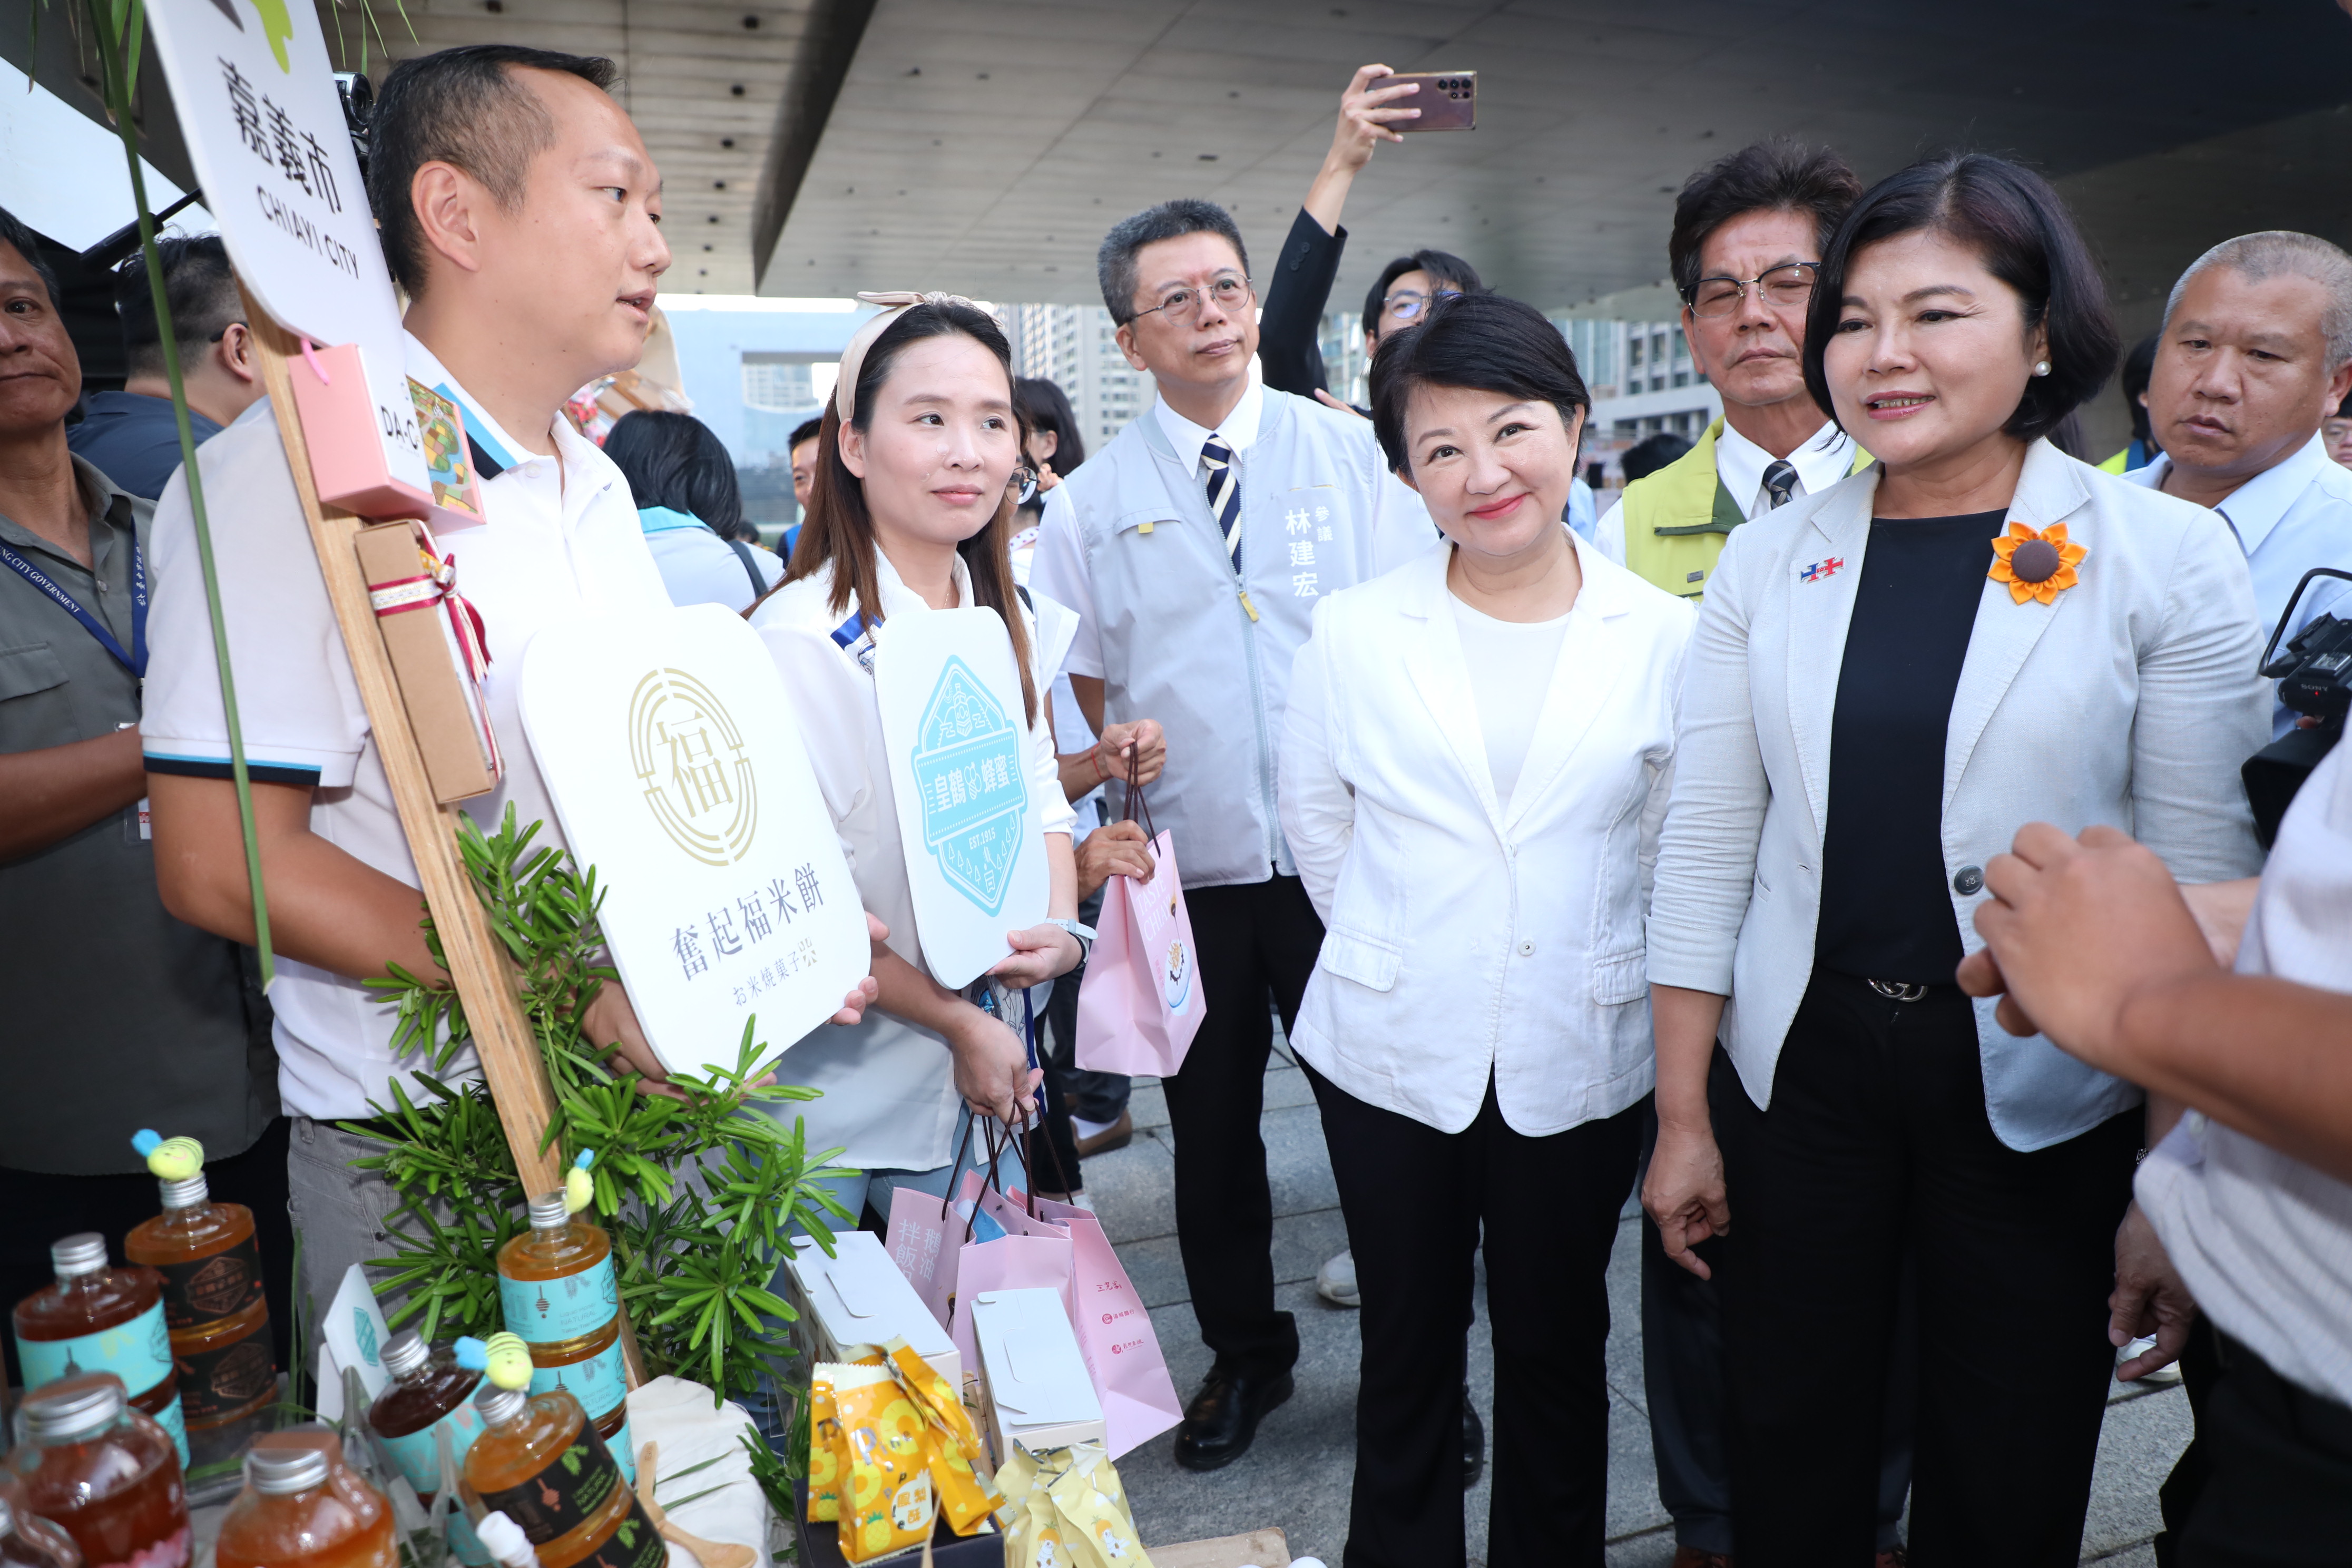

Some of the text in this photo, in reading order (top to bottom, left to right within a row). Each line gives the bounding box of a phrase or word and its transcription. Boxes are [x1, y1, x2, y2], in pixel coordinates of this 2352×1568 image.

[218, 55, 342, 214] 嘉義市
[257, 184, 359, 280] CHIAYI CITY
[1285, 508, 1319, 597] 林建宏
[1315, 506, 1333, 542] 參議
[12, 558, 33, 573] CITY
[30, 571, 81, 613] GOVERNMENT
[655, 710, 734, 818] 福
[935, 753, 1010, 812] 皇鶴 蜂蜜
[968, 827, 996, 850] EST.1915
[1136, 871, 1167, 916] TASTE
[669, 863, 824, 982] 奮起福米餅
[919, 1228, 942, 1283] 鵝油
[560, 1310, 597, 1326] NATURAL
